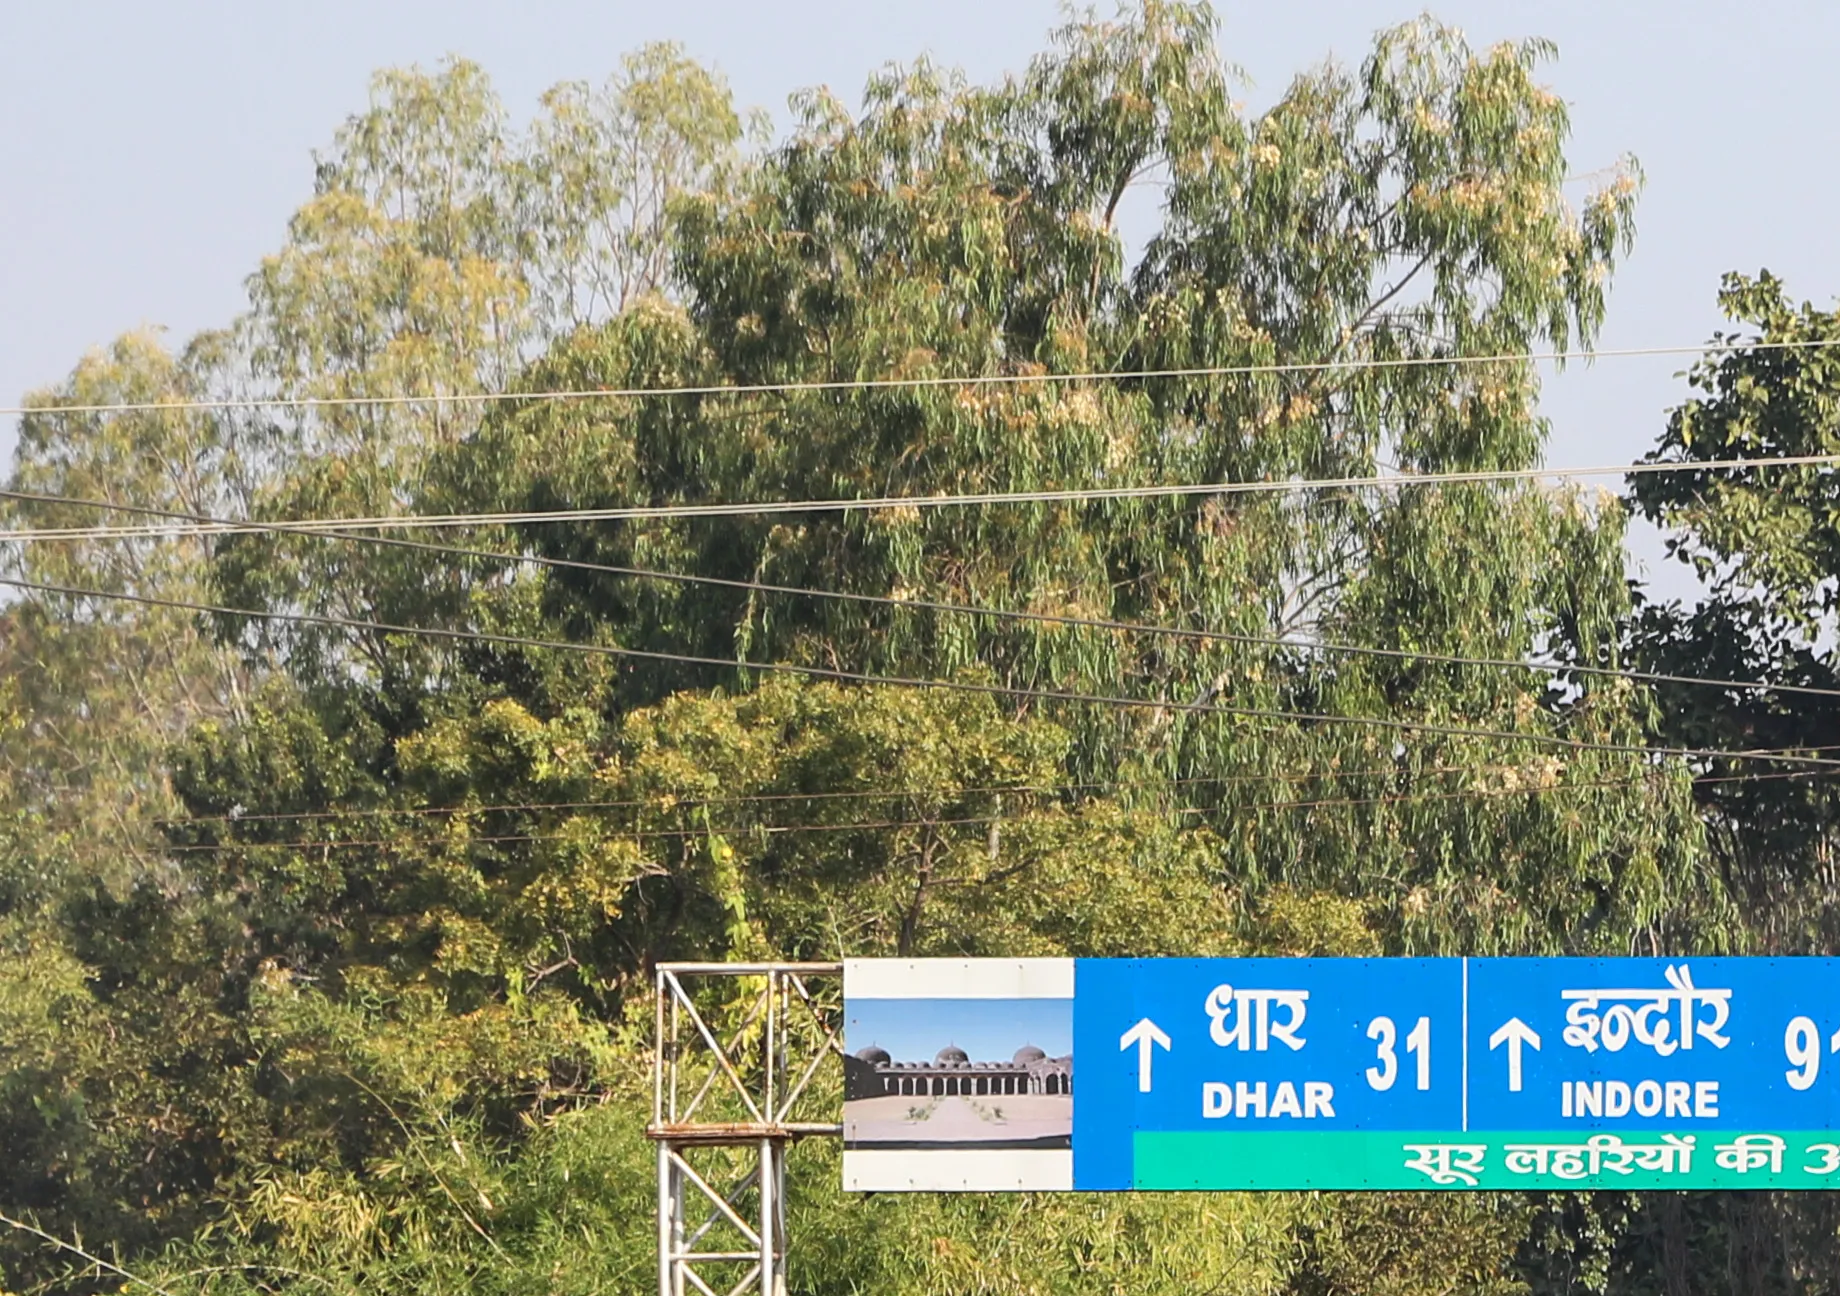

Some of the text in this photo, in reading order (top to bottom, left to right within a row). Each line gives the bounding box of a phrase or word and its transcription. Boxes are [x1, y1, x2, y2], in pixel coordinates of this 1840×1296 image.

[1204, 983, 1310, 1051] धार
[1561, 963, 1733, 1057] इन्दौर
[1365, 1016, 1430, 1091] 31
[1202, 1081, 1336, 1119] DHAR
[1561, 1080, 1719, 1118] INDORE
[1403, 1144, 1487, 1186] सूर
[1503, 1134, 1696, 1179] लहरियों
[1714, 1134, 1787, 1173] की
